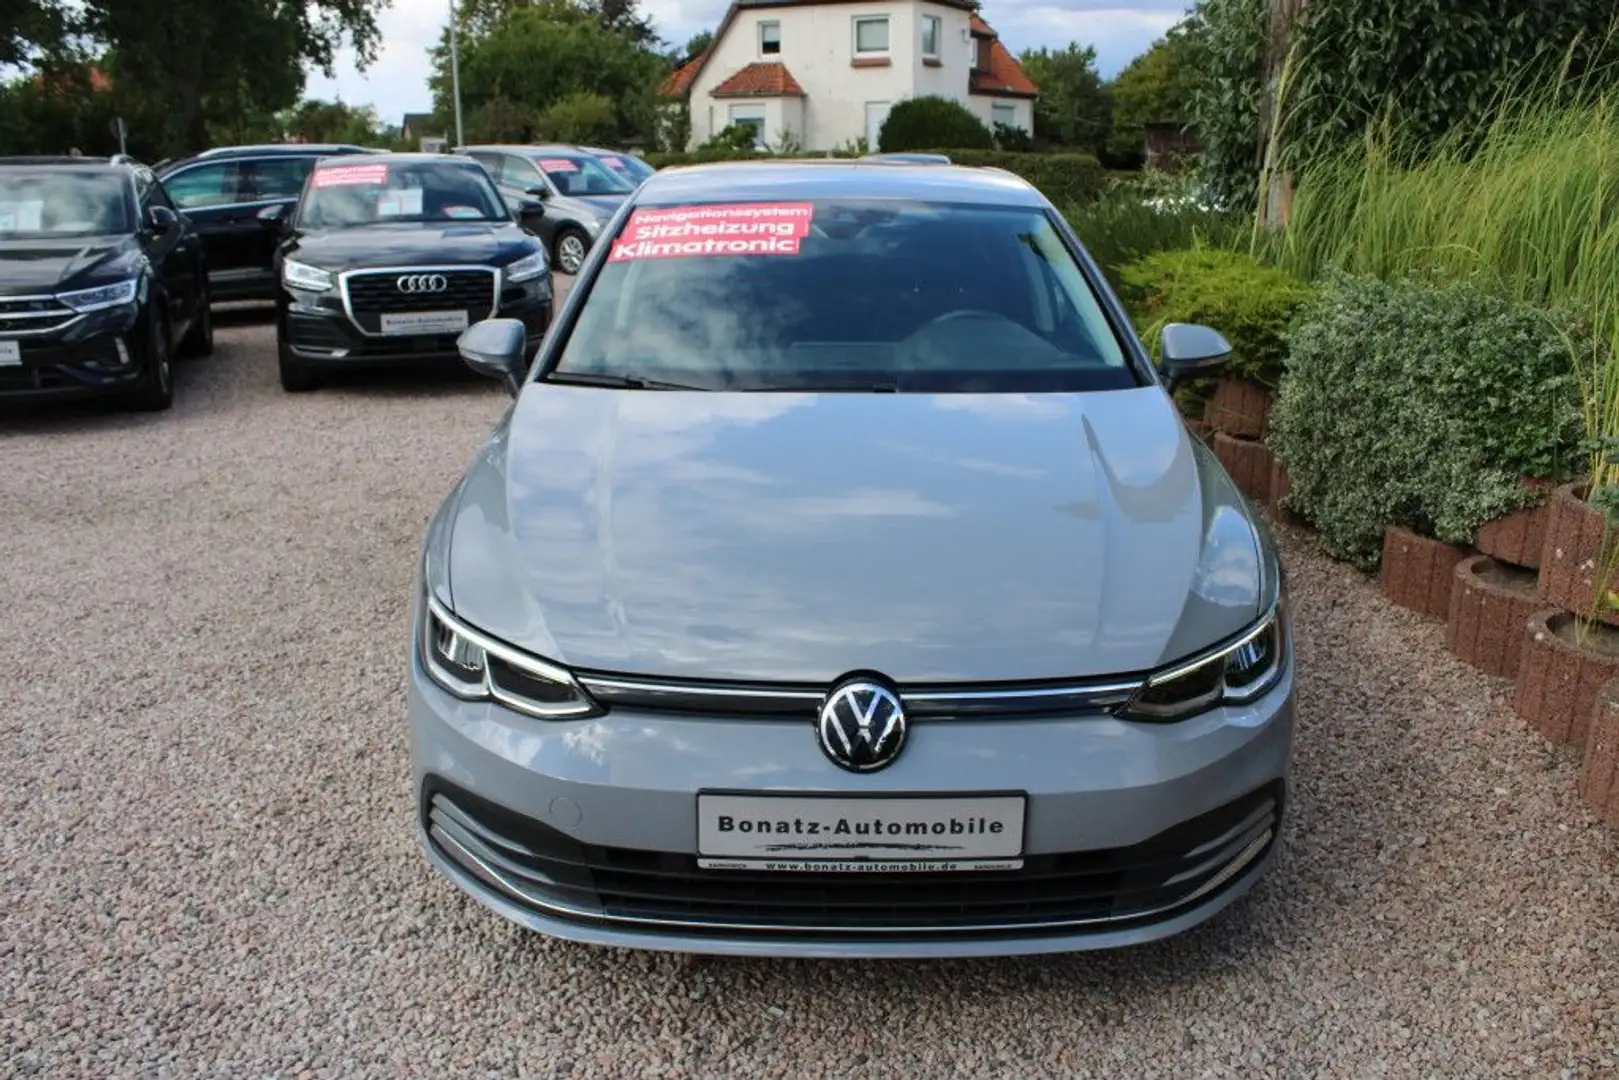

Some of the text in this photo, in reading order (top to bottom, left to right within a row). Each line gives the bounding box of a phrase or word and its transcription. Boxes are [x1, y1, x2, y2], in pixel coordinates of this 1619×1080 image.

[635, 207, 809, 225] Navigationssystem
[635, 221, 794, 239] Sitzheizung
[614, 237, 795, 258] Klimatronic
[718, 815, 1005, 836] Bonatz-Automobile
[765, 861, 958, 872] www.bonatz-automobile.de
